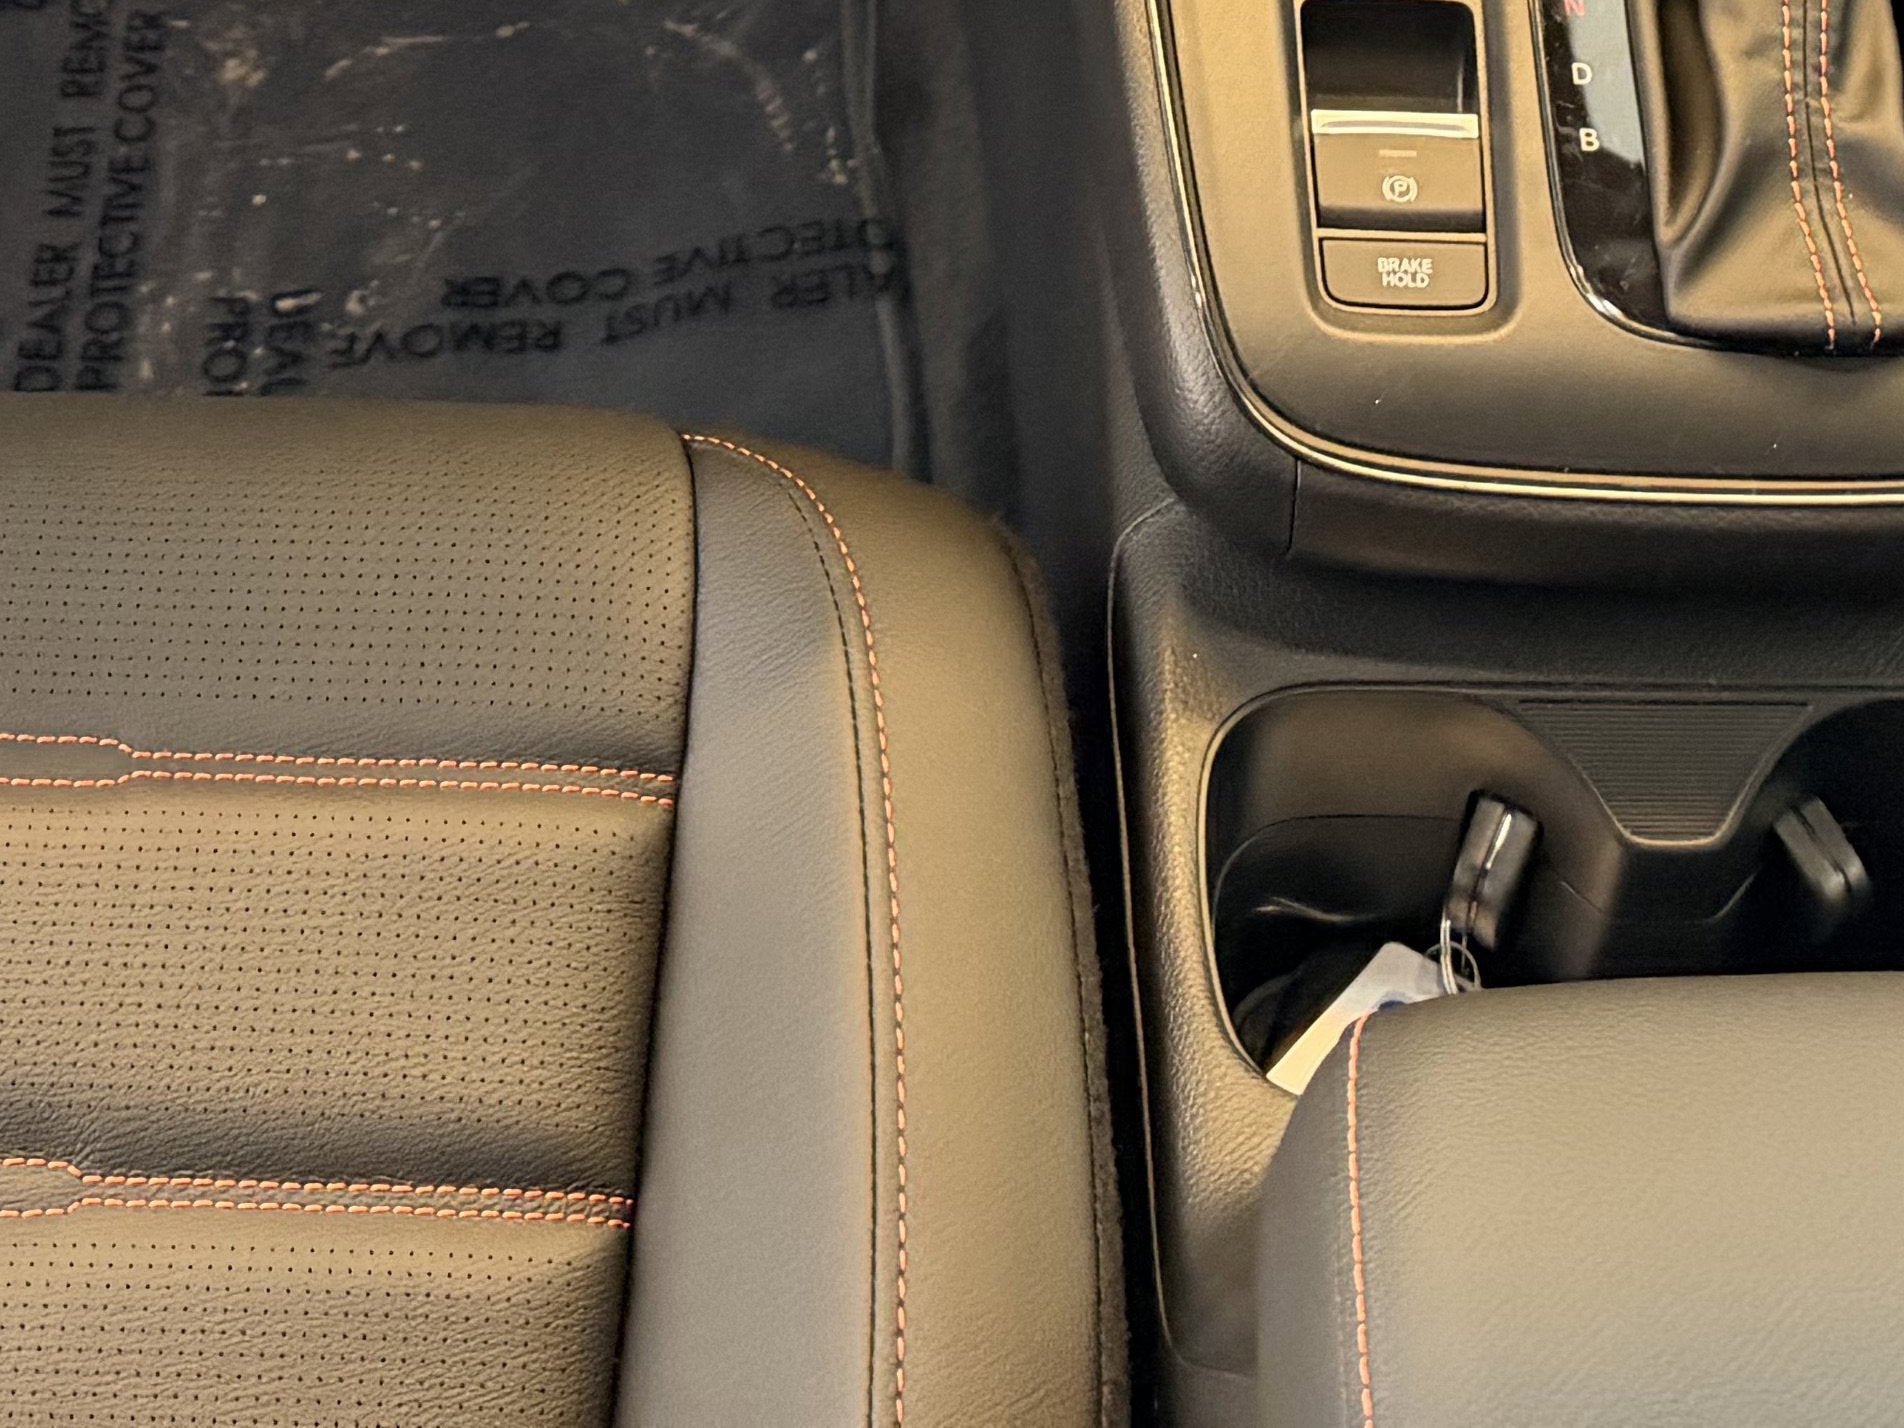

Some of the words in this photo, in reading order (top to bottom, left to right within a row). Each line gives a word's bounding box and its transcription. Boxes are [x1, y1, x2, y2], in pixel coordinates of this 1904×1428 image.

[112, 8, 168, 145] COVER
[1571, 63, 1593, 85] D
[1579, 128, 1599, 152] B
[42, 124, 96, 219] MUST
[74, 154, 152, 392] PROTECTIVE
[440, 267, 633, 310] COVER
[1377, 256, 1433, 274] BRAKE
[1381, 271, 1431, 289] HOLD
[13, 242, 77, 393] DEALER
[326, 320, 565, 372] REMOVE
